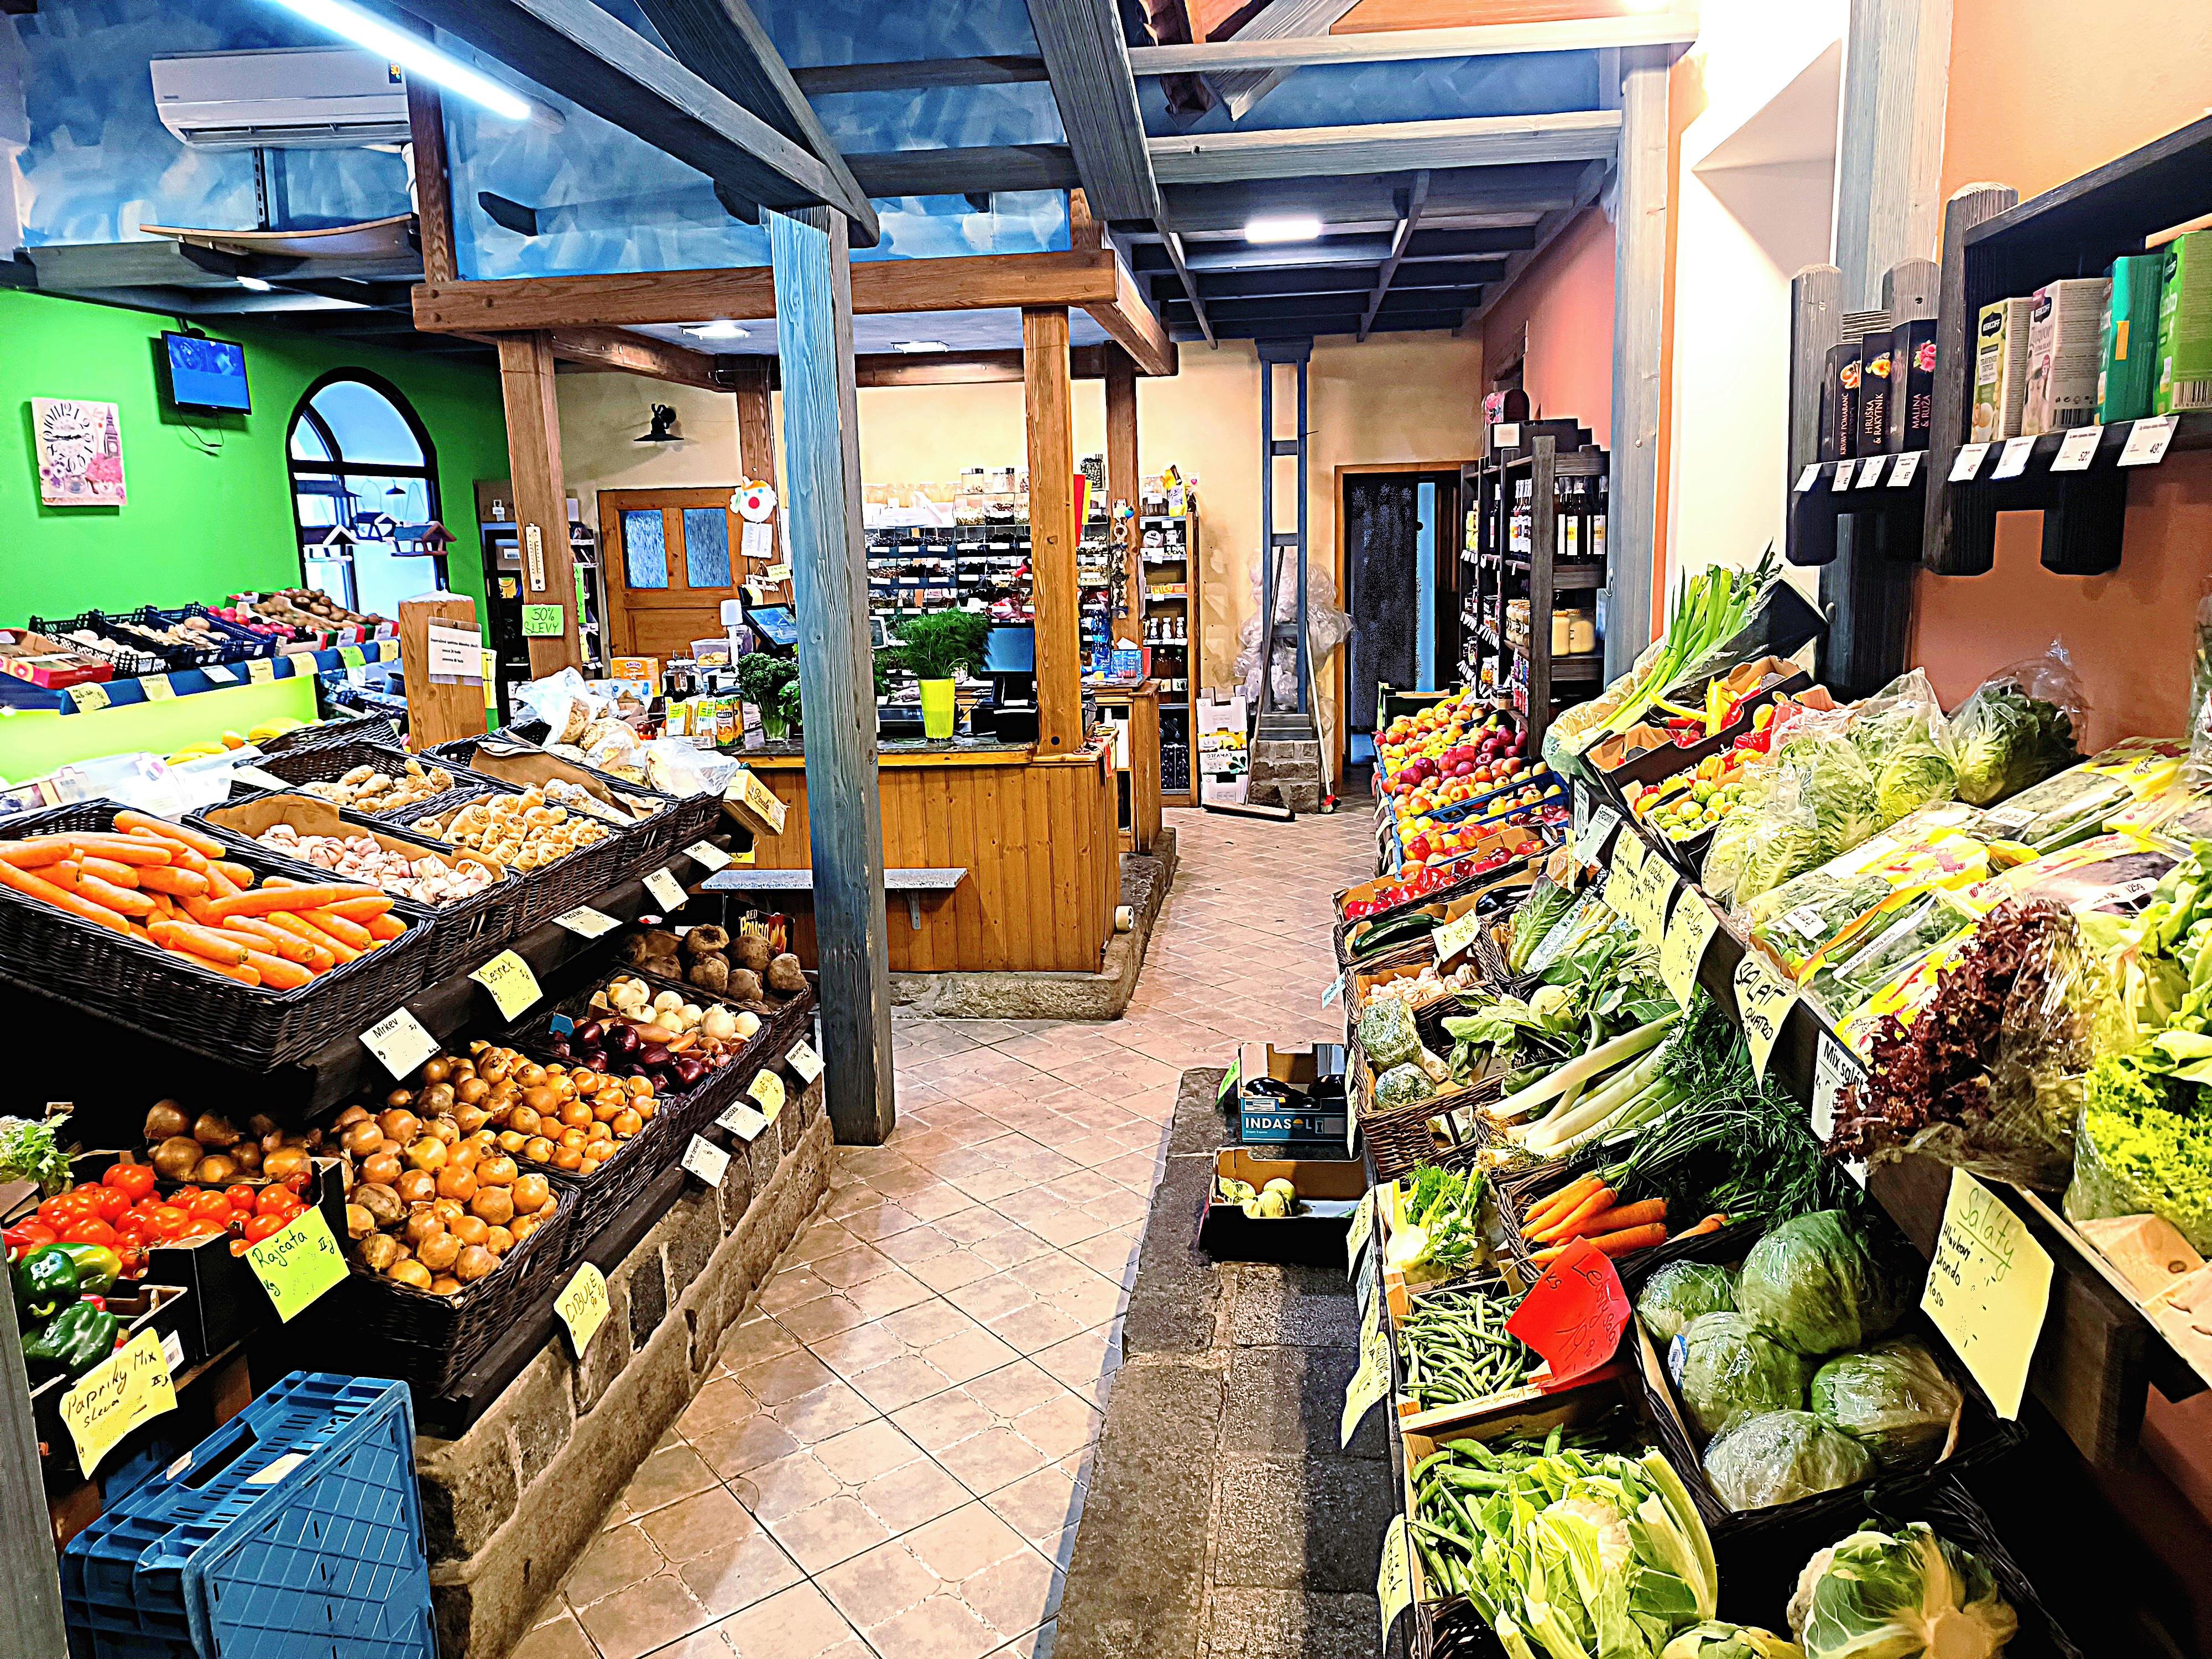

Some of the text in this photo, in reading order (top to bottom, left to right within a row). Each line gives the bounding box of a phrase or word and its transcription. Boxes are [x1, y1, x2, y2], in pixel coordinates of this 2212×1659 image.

[1865, 400, 1874, 434] HRUŠKA
[1874, 393, 1884, 435] RAKYTNÍK
[1912, 394, 1921, 429] MALINA
[524, 621, 559, 634] SLEVY
[531, 607, 554, 620] 50%
[746, 909, 758, 920] RED
[372, 1018, 398, 1039] Mrkev
[1824, 1040, 1840, 1071] Mix
[252, 1229, 308, 1268] Rajčata
[1959, 1187, 2014, 1282] Saláty
[565, 1272, 597, 1323] CIBULE
[1927, 1271, 1944, 1307] Roso
[67, 1349, 157, 1422] Papriky Mix
